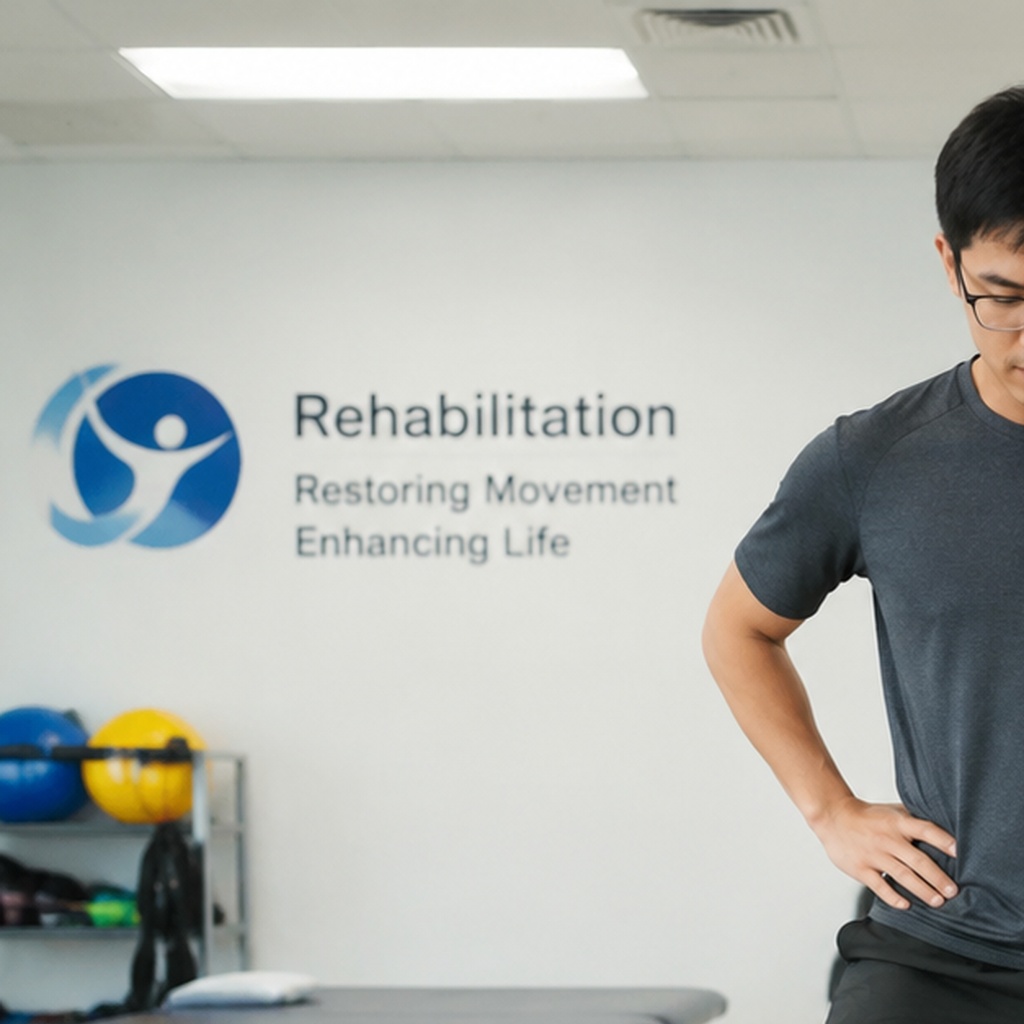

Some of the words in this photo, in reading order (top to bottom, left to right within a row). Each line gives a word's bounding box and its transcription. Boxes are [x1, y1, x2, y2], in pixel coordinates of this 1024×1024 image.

[294, 392, 677, 439] Rehabilitation
[295, 473, 470, 513] Restoring
[486, 473, 678, 505] Movement
[295, 525, 489, 565] Enhancing
[504, 525, 571, 557] Life
